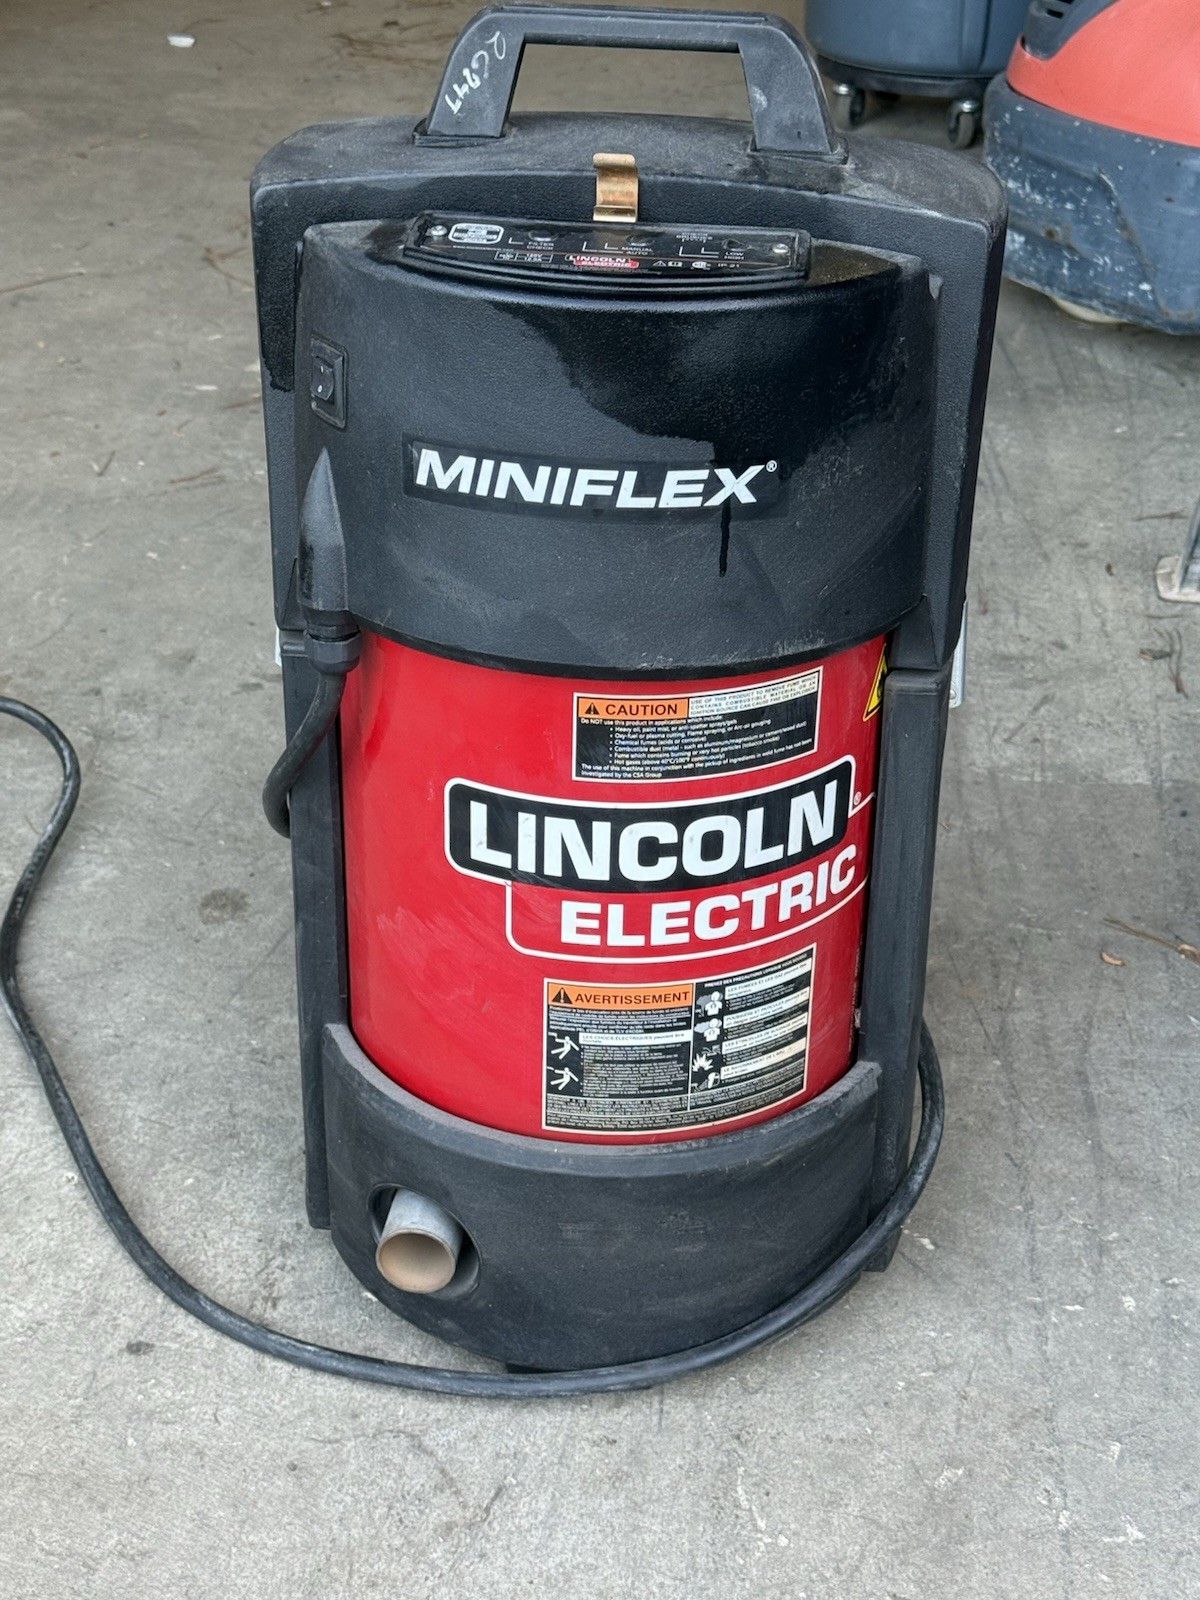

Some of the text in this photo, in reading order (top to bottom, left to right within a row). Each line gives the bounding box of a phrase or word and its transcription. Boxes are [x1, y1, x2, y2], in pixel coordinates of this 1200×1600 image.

[726, 696, 766, 706] COMBUSTIBLE
[770, 688, 796, 697] MATERIAL
[728, 692, 754, 700] PRODUCT
[765, 684, 786, 693] REMOVE
[606, 704, 678, 716] CAUTION
[678, 723, 708, 731] anti-spatter
[750, 720, 771, 728] gouging
[720, 744, 741, 752] particles
[763, 736, 780, 744] smoke)
[691, 753, 726, 762] continuously)
[729, 754, 756, 764] ingredients
[470, 780, 838, 882] LINCOLN
[560, 844, 857, 947] ELECTRIC
[575, 991, 690, 1004] AVERTISSEMENT
